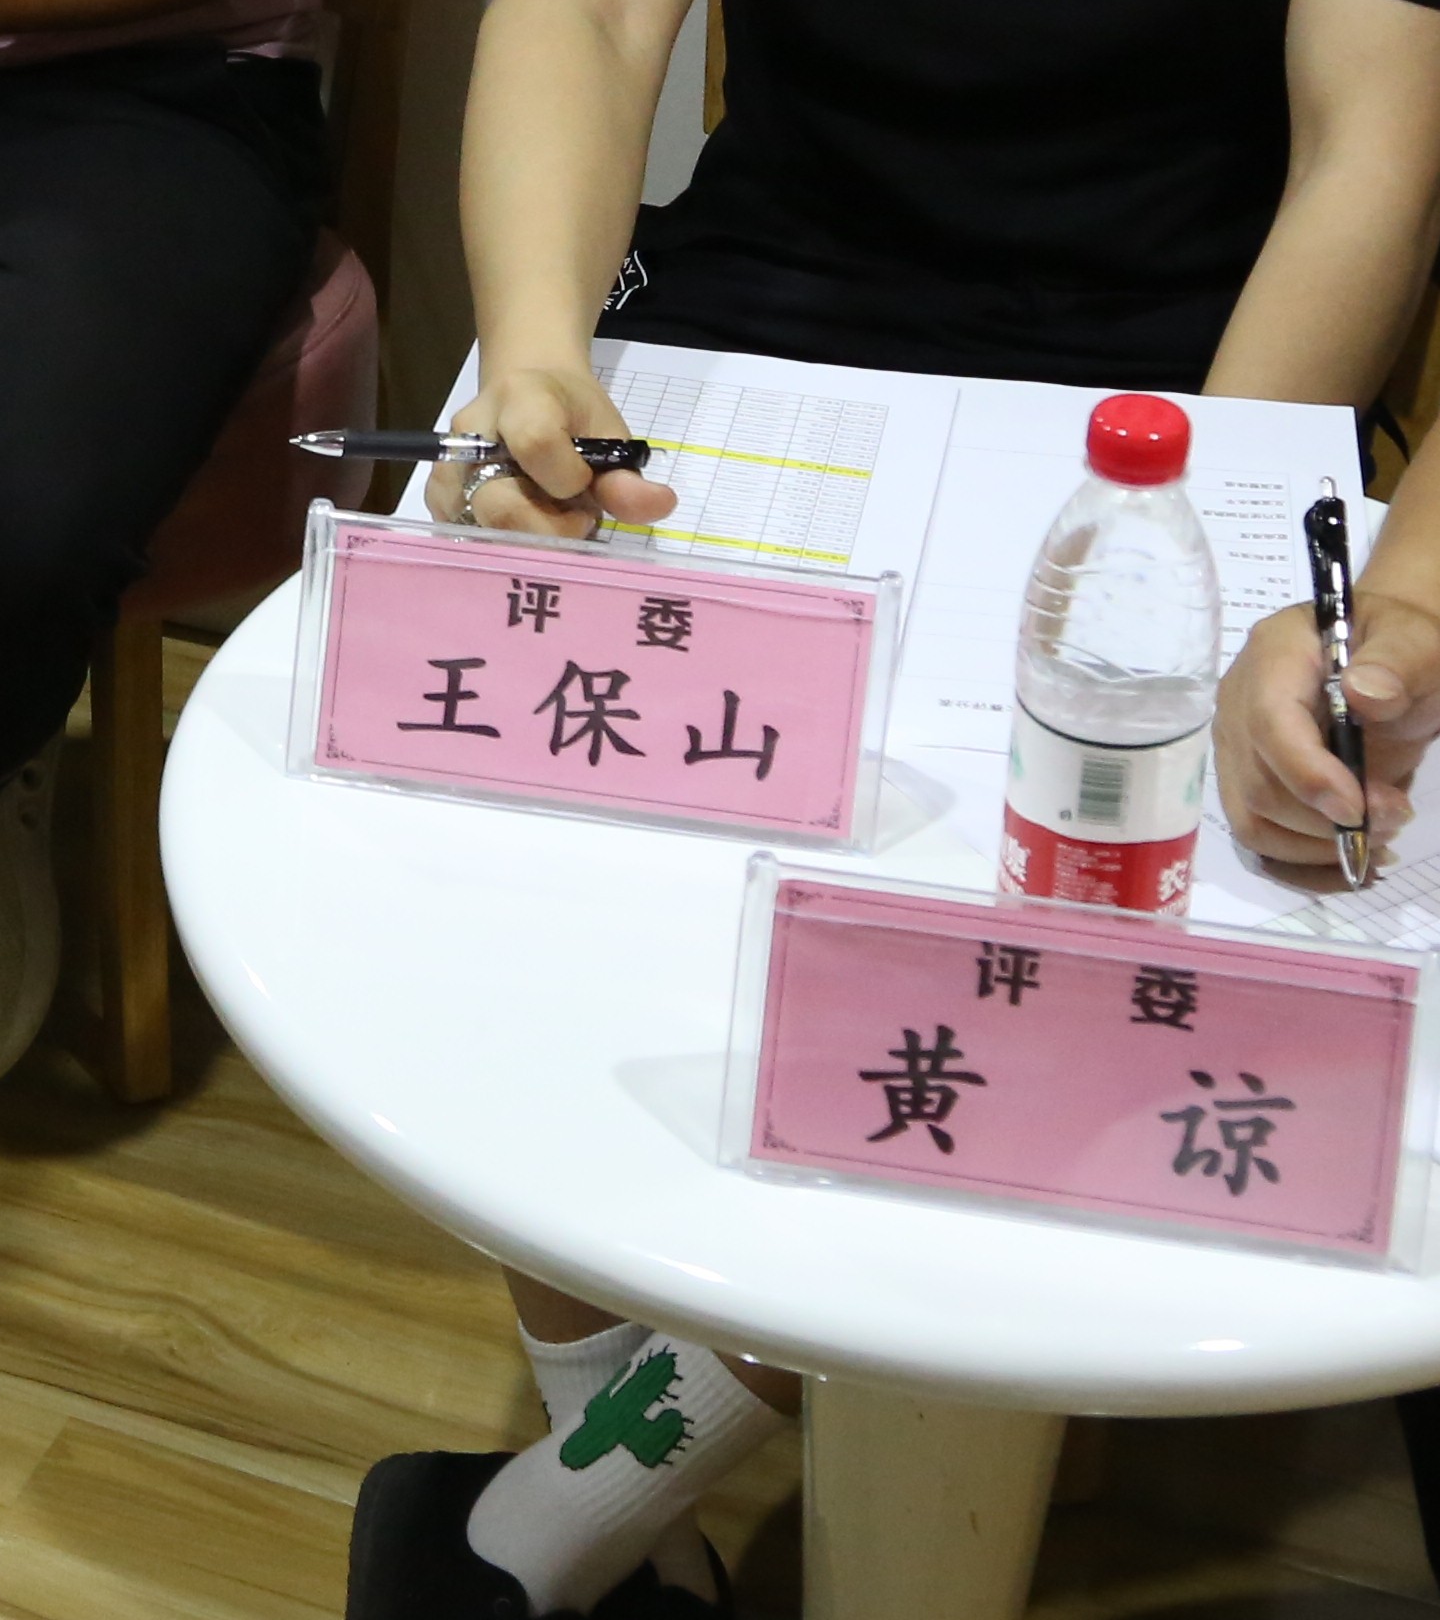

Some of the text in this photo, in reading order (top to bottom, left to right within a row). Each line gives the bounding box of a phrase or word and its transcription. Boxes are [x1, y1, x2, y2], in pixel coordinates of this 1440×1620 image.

[505, 578, 694, 653] 评委
[396, 656, 781, 782] 王保山
[976, 940, 1200, 1032] 评委
[858, 1023, 1297, 1197] 黄谅
